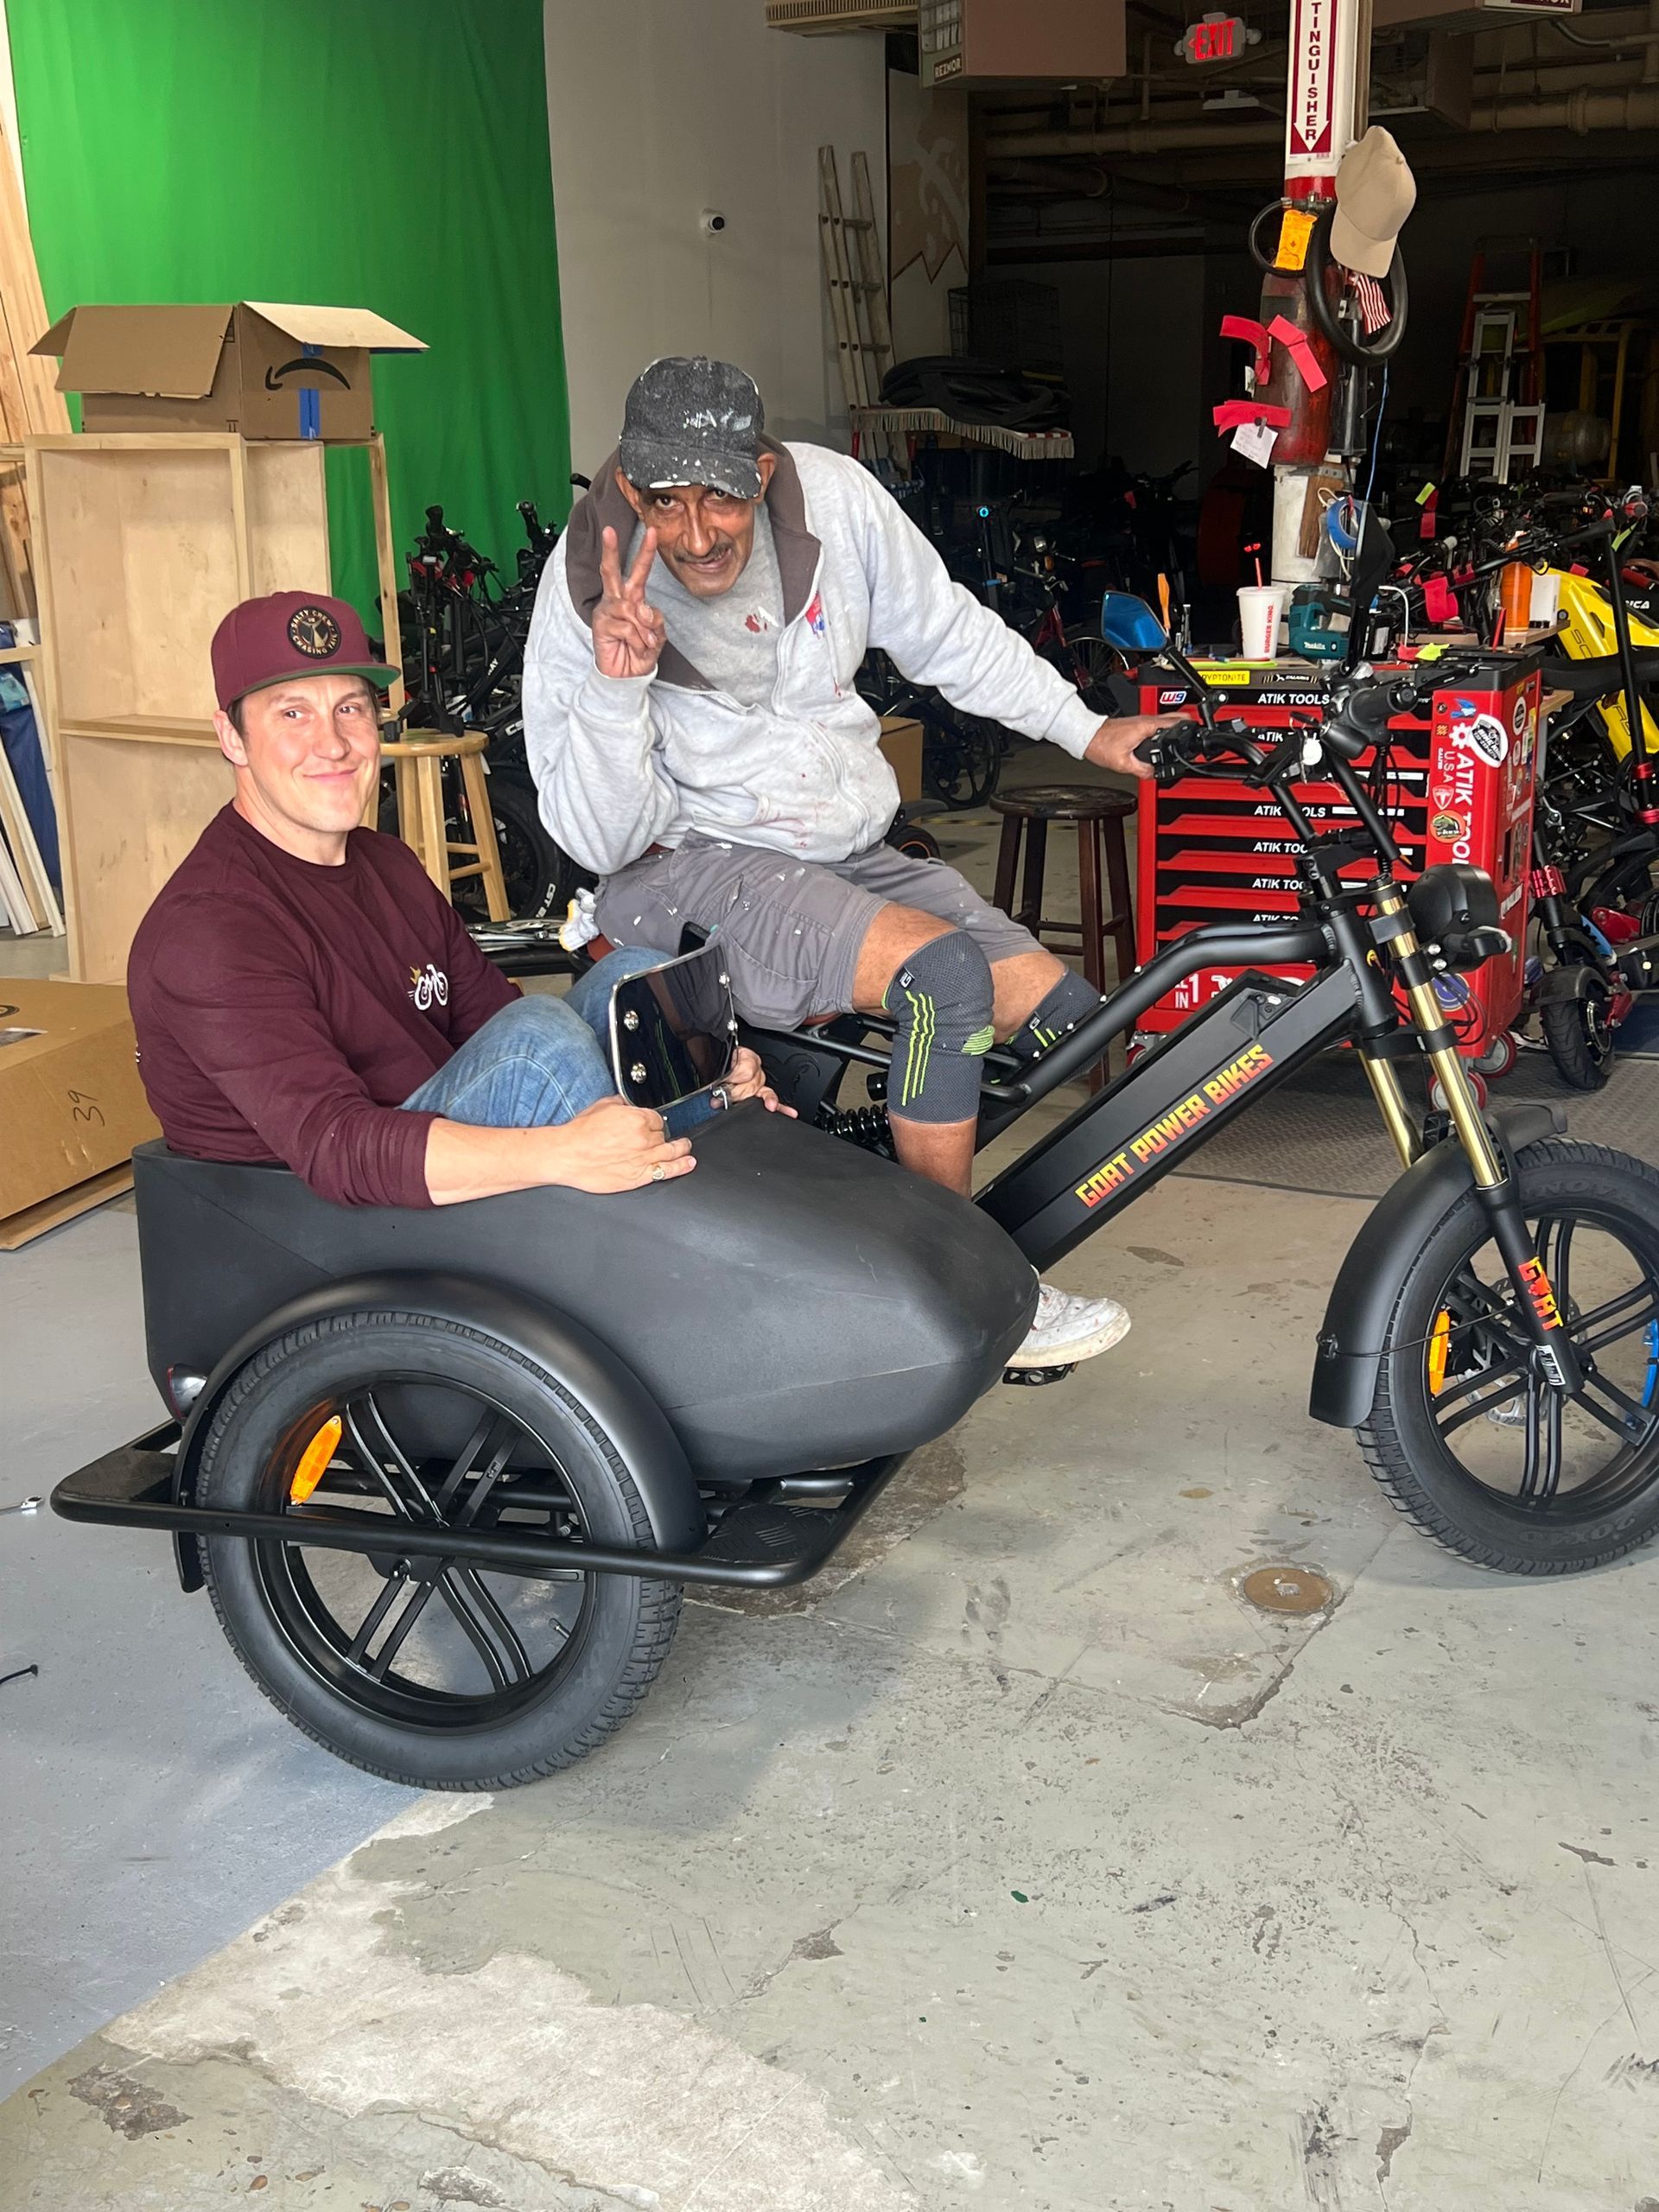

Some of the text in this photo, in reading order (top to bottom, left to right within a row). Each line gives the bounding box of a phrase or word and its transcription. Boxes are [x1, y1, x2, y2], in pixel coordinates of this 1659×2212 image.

[1194, 19, 1236, 60] EXIT
[934, 57, 963, 79] REZNOR
[290, 609, 309, 629] SALTY
[292, 635, 327, 655] CHASING
[1257, 694, 1331, 705] ATIK TOOLS
[1454, 753, 1475, 806] ATIK
[1254, 805, 1282, 817] ATIK
[1253, 842, 1281, 854] ATIK
[1252, 878, 1281, 890] ATIK
[1175, 991, 1189, 1009] IN
[67, 1089, 105, 1127] 39
[1074, 1044, 1274, 1209] GOAT POWER BIKES
